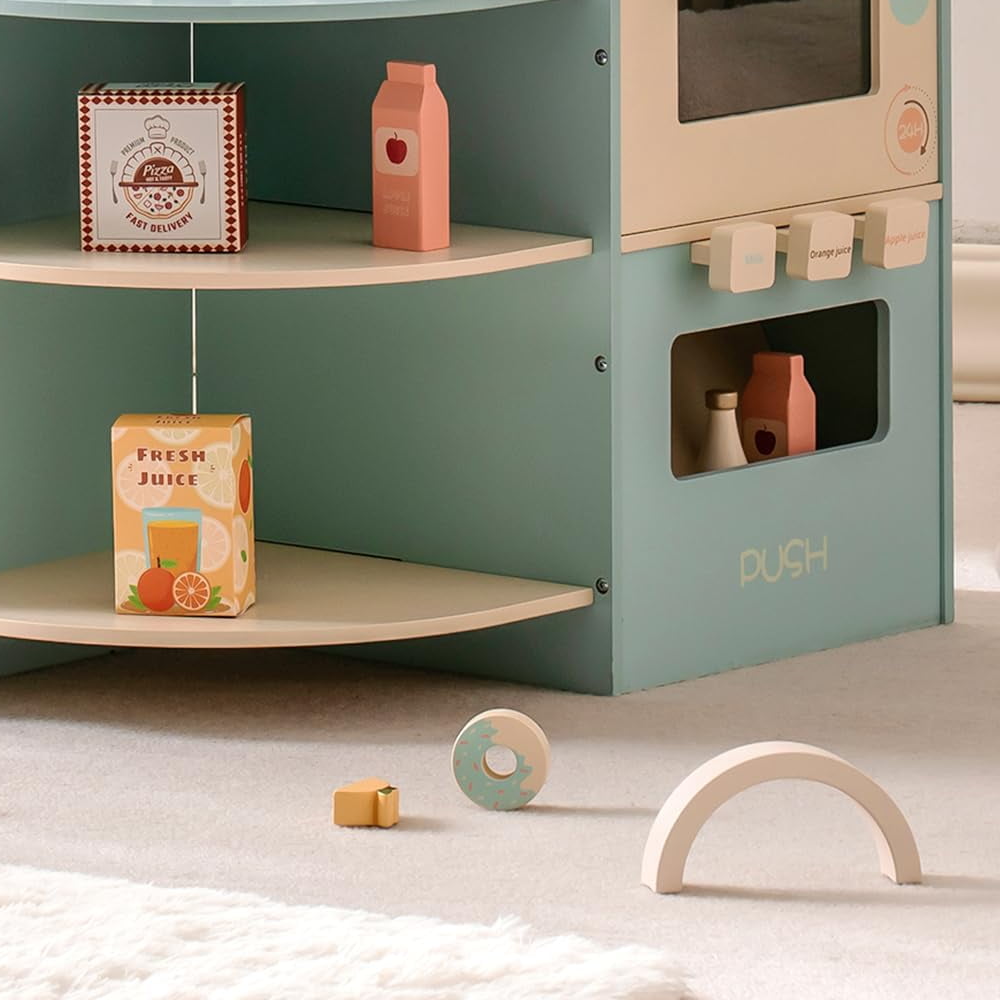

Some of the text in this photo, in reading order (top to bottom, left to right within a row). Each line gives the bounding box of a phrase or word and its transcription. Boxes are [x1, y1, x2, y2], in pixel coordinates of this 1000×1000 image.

[142, 164, 175, 177] Pizza
[126, 211, 193, 233] FAST DELIVERY
[810, 244, 851, 261] Orange juice
